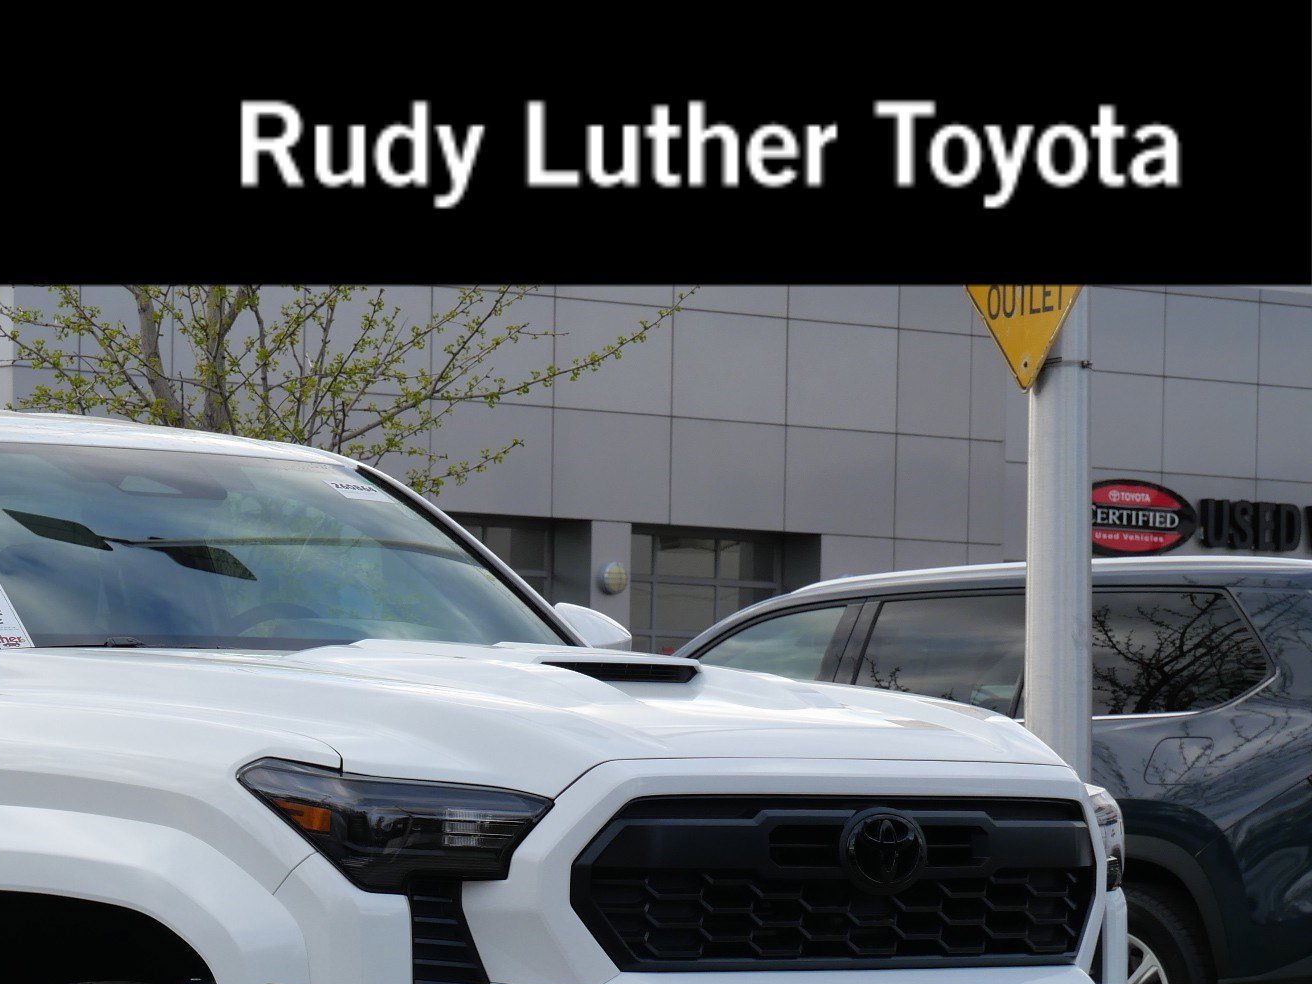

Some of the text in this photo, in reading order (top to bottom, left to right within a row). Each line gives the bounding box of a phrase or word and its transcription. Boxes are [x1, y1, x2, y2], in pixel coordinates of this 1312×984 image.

[1121, 492, 1150, 502] TOYOTA
[1200, 498, 1301, 552] USED
[1095, 532, 1164, 543] Used Vehicles
